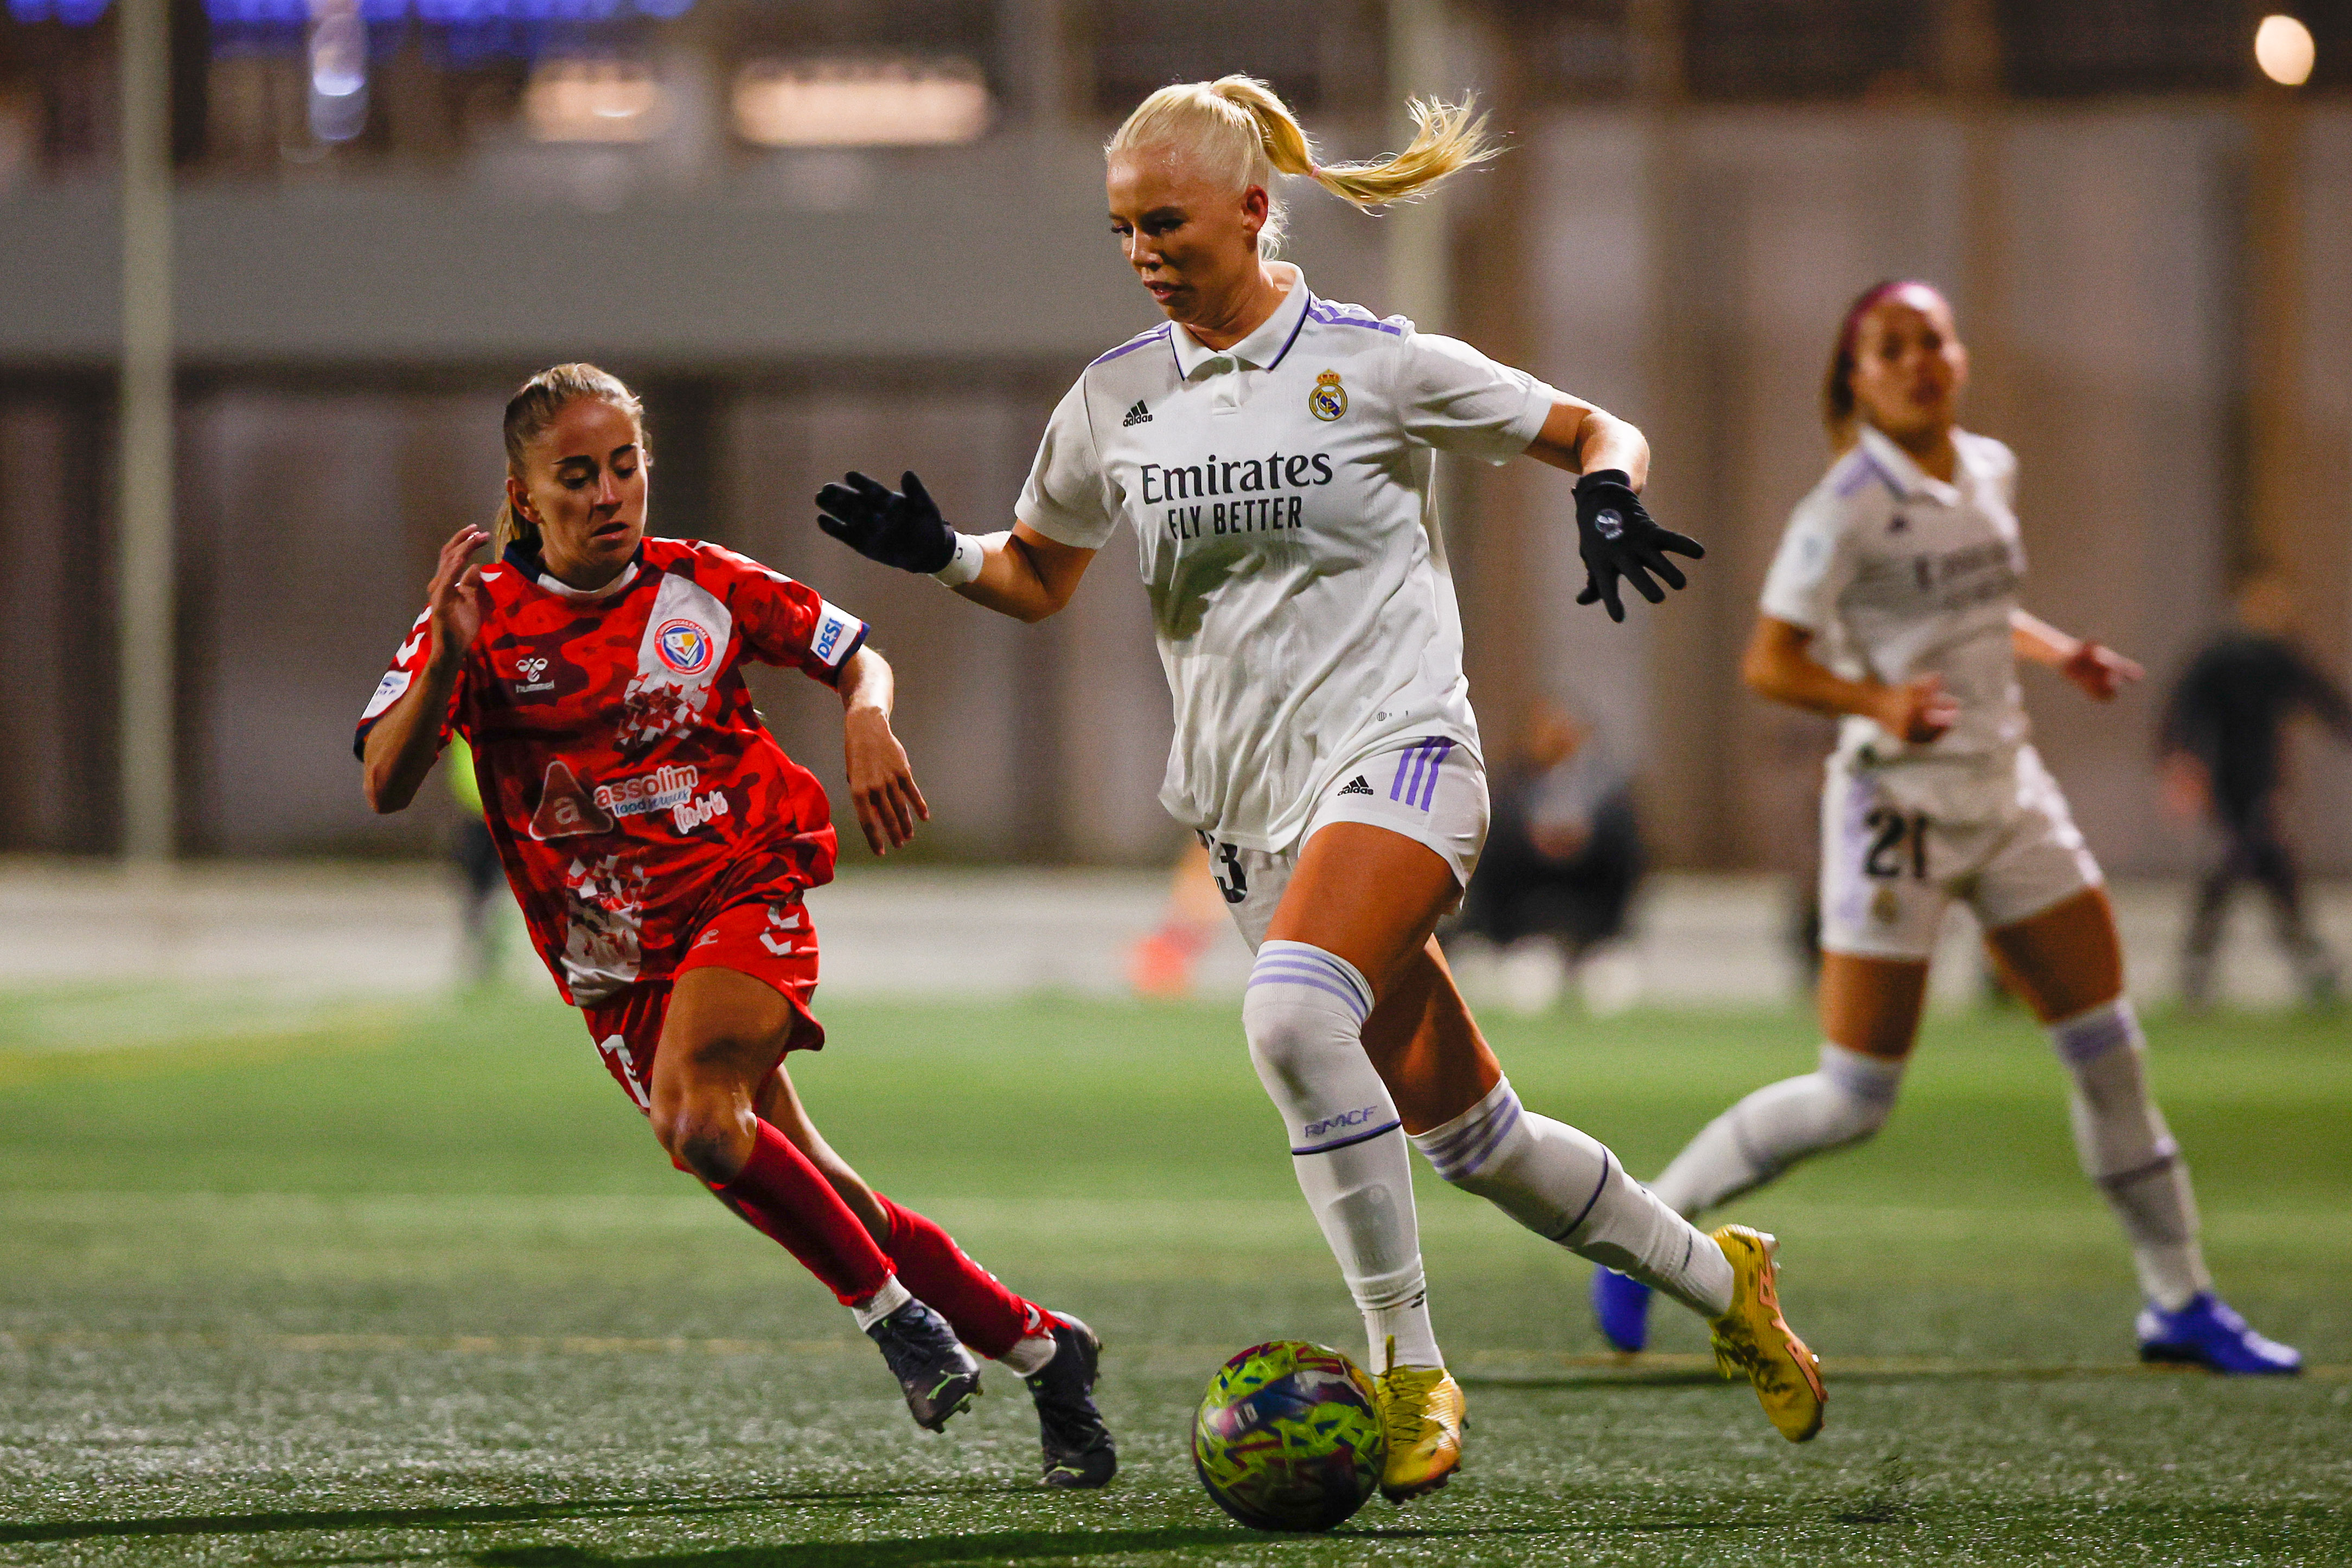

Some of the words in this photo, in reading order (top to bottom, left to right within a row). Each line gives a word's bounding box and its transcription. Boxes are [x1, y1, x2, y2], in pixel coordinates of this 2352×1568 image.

[1123, 413, 1153, 427] adidas
[1141, 451, 1333, 505] Emirates
[1168, 505, 1201, 540] FLY
[1213, 496, 1302, 535] BETTER
[597, 767, 696, 807] assolim
[1337, 786, 1373, 796] adidas
[1863, 807, 1929, 879] 21
[1305, 1105, 1377, 1138] RMCF
